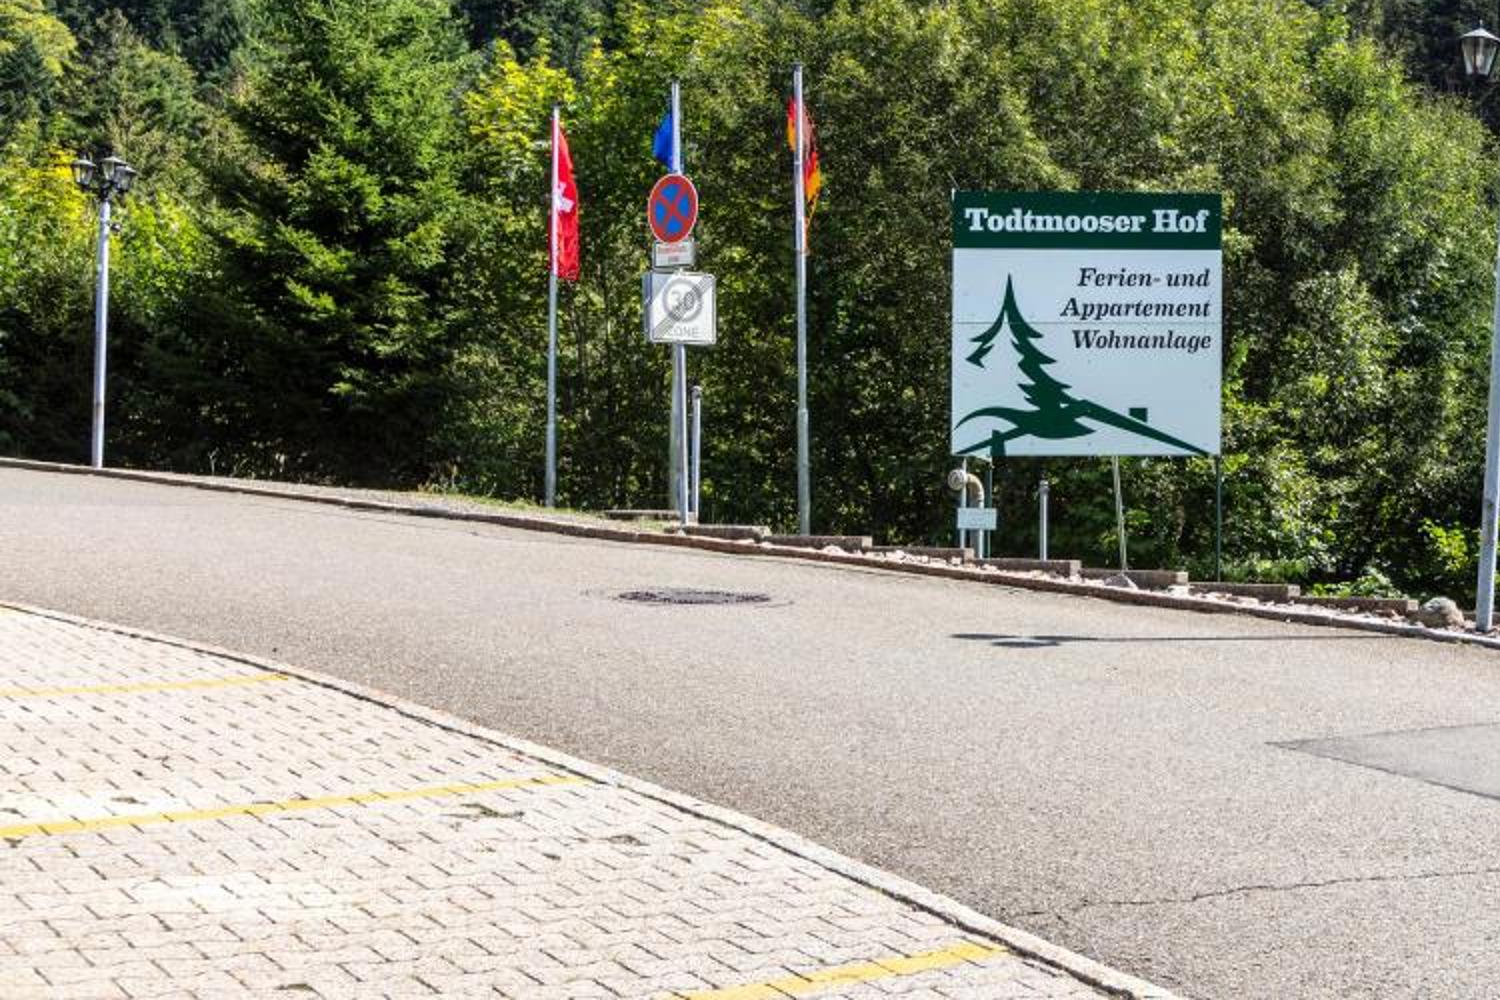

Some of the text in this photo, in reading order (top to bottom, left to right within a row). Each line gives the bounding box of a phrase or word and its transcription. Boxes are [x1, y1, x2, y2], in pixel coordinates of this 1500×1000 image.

[964, 207, 1210, 233] Todtmooser Hof
[1077, 267, 1210, 288] Ferien- und
[671, 290, 695, 313] 30
[1060, 298, 1211, 321] Appartement
[1072, 329, 1212, 354] Wohnanlage
